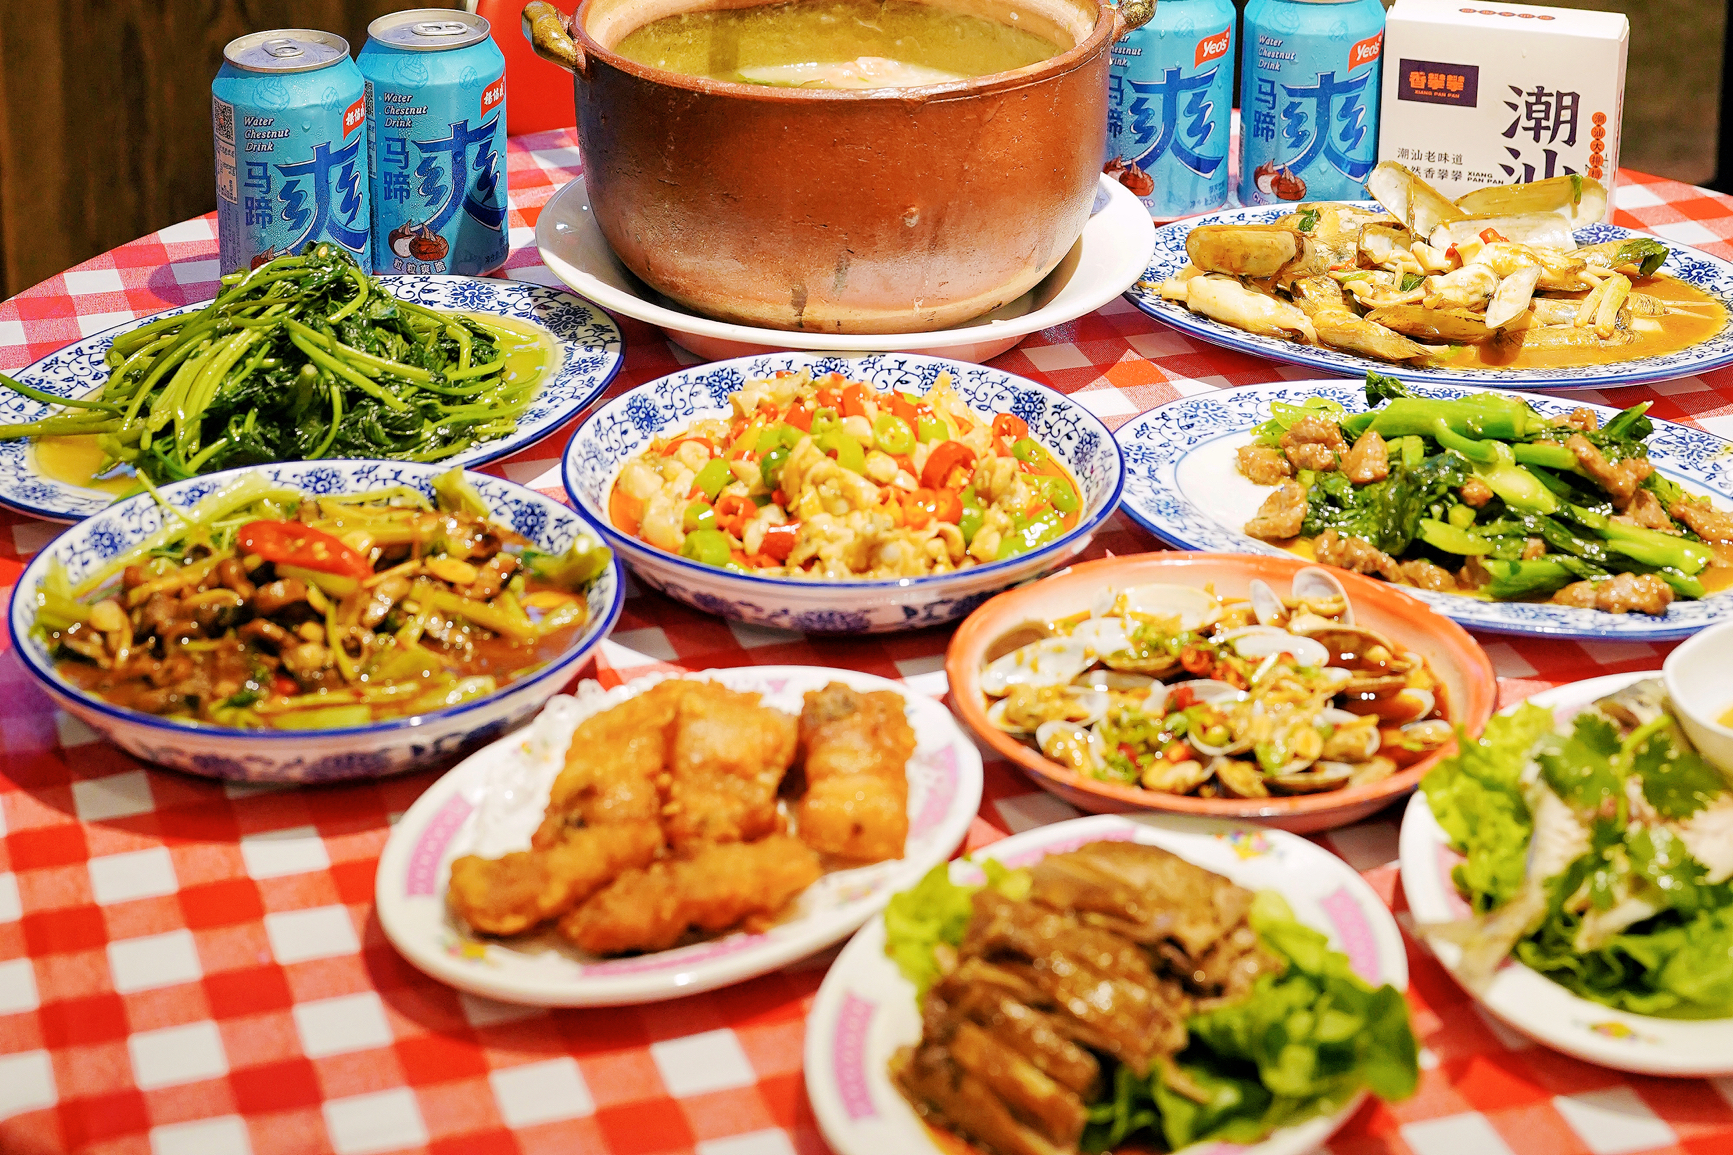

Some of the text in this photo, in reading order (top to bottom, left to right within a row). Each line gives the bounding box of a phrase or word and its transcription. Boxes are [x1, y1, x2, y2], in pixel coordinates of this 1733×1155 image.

[1202, 38, 1228, 58] Yeo's
[1258, 34, 1283, 47] Water
[1111, 46, 1142, 56] hestnut
[1258, 48, 1296, 60] Chestnut
[1356, 41, 1380, 62] Yeo's
[1257, 59, 1282, 72] Drink
[383, 92, 413, 103] Water
[384, 105, 428, 115] Chestnut
[1252, 77, 1278, 143] 马蹄
[243, 116, 274, 127] Water
[384, 117, 413, 128] Drink
[1121, 64, 1224, 180] 爽
[1273, 68, 1375, 184] 爽
[244, 128, 290, 139] Chestnut
[245, 142, 275, 152] Drink
[1397, 147, 1464, 165] 潮汕老味道
[383, 136, 410, 204] 马蹄
[411, 110, 507, 233] 爽
[244, 161, 273, 229] 马蹄
[273, 131, 370, 255] 爽
